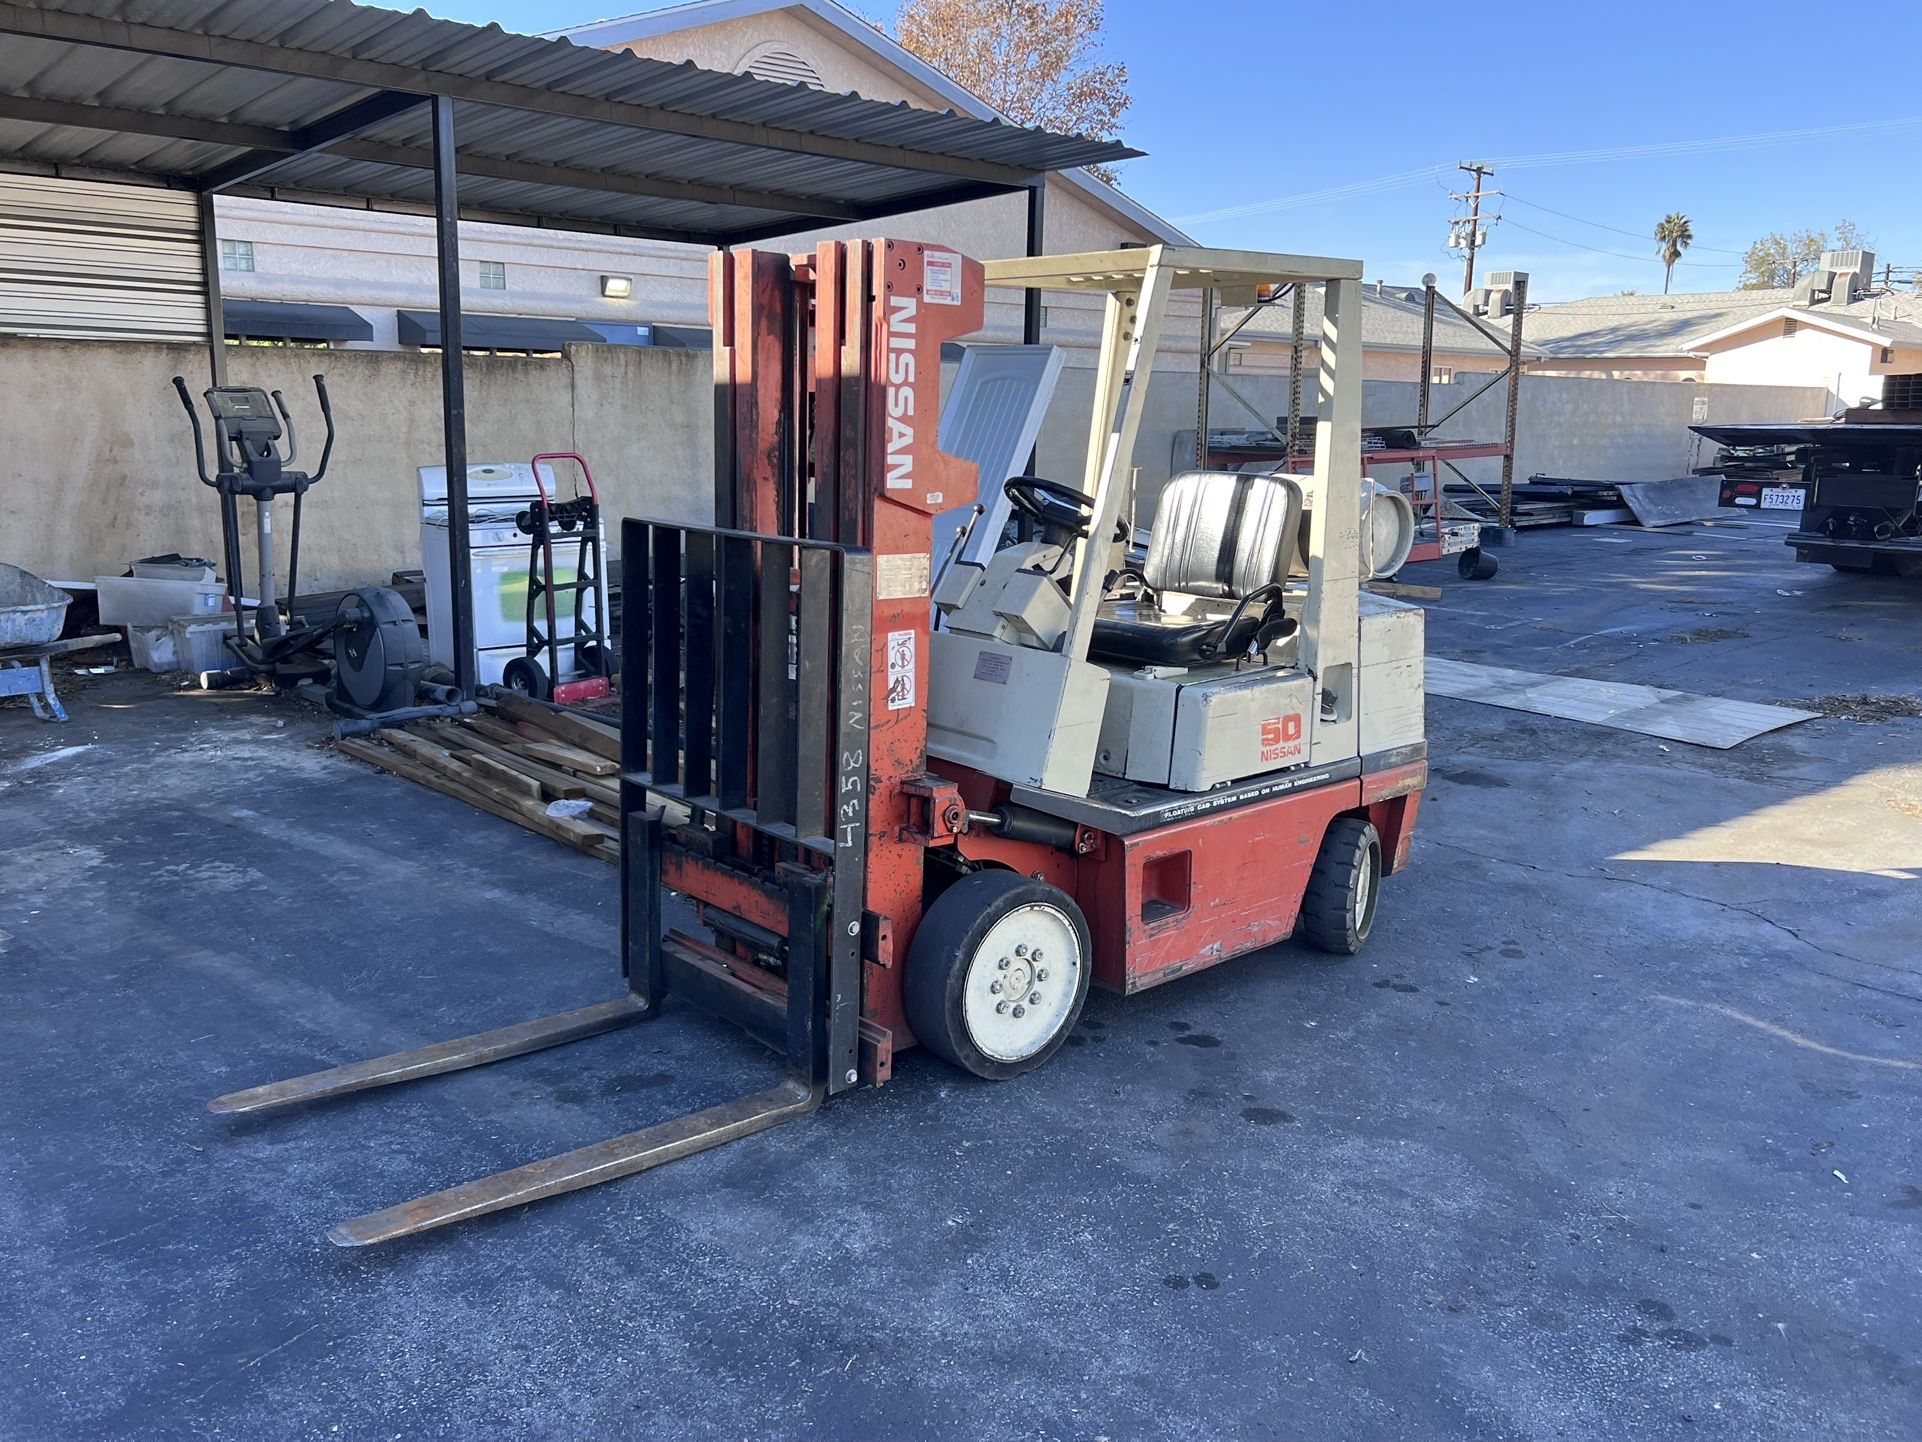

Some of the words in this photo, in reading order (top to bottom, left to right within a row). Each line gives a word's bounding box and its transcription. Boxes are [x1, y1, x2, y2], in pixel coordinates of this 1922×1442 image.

[886, 295, 917, 489] NISSAN
[1764, 494, 1801, 504] F573275
[1261, 713, 1301, 746] 50
[1261, 743, 1301, 762] NISSAN
[1212, 796, 1237, 807] SYSTEM
[1239, 790, 1259, 800] BASED
[1272, 782, 1292, 792] HUMAN
[1294, 773, 1330, 787] ENGINEERING
